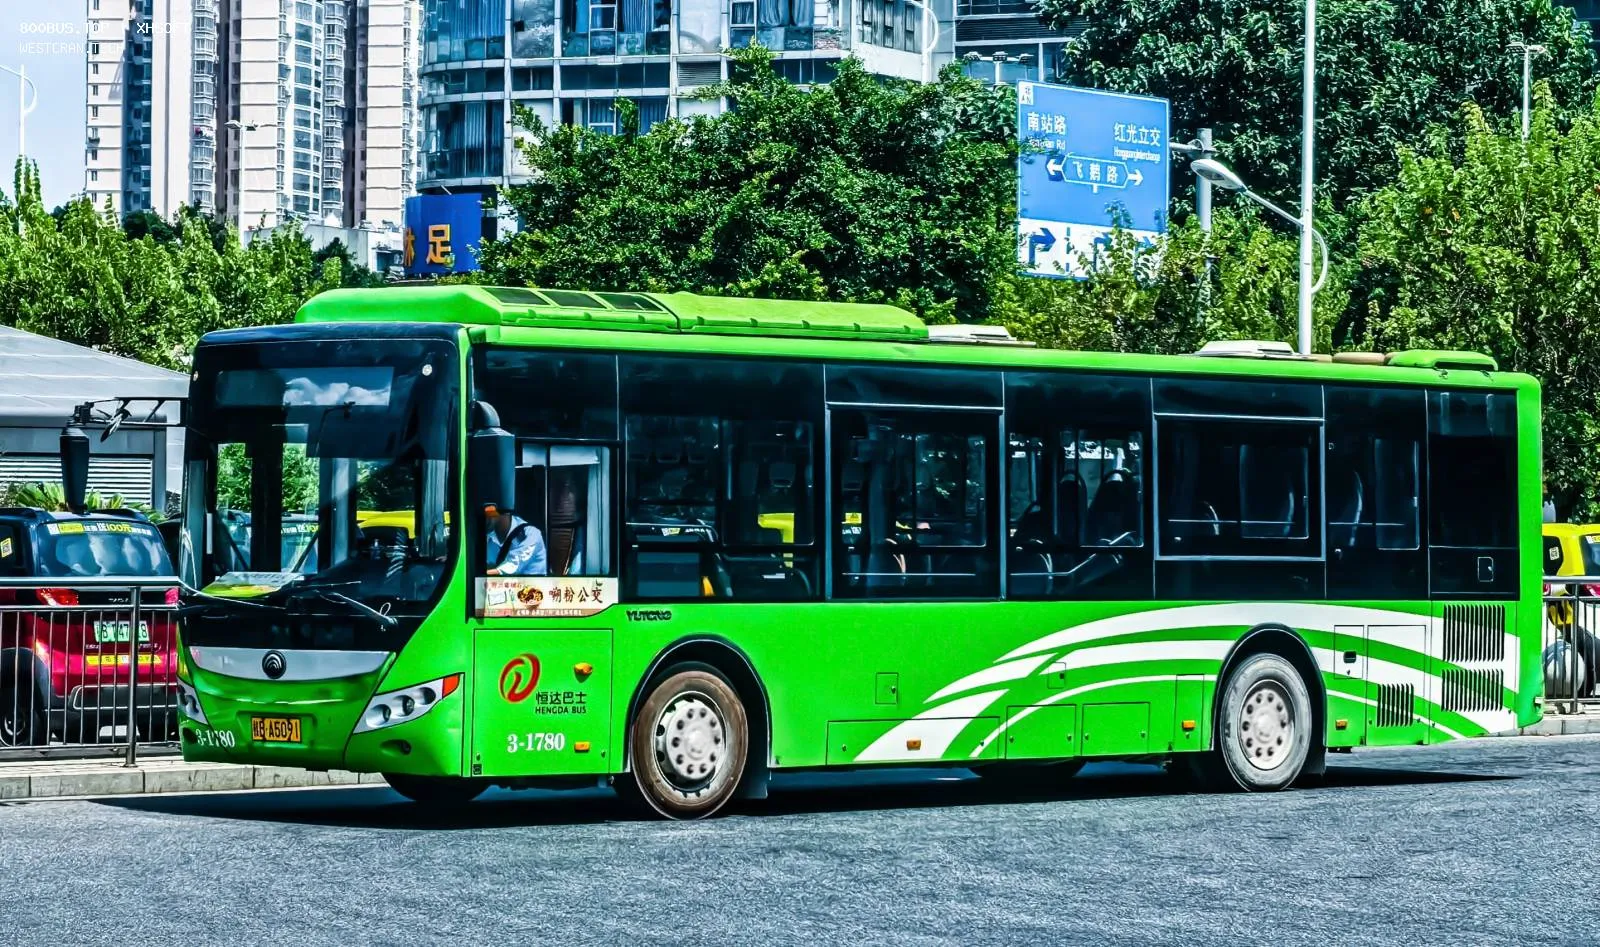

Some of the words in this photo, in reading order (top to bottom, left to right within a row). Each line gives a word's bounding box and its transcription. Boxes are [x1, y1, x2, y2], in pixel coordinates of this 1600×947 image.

[1027, 111, 1067, 135] 南站路
[1113, 122, 1161, 147] 红光立交
[535, 691, 587, 705] 恒达巴士
[535, 705, 569, 715] HENGDA
[571, 705, 587, 714] BUS
[195, 728, 236, 748] 3-1780
[507, 732, 566, 753] 3-1780
